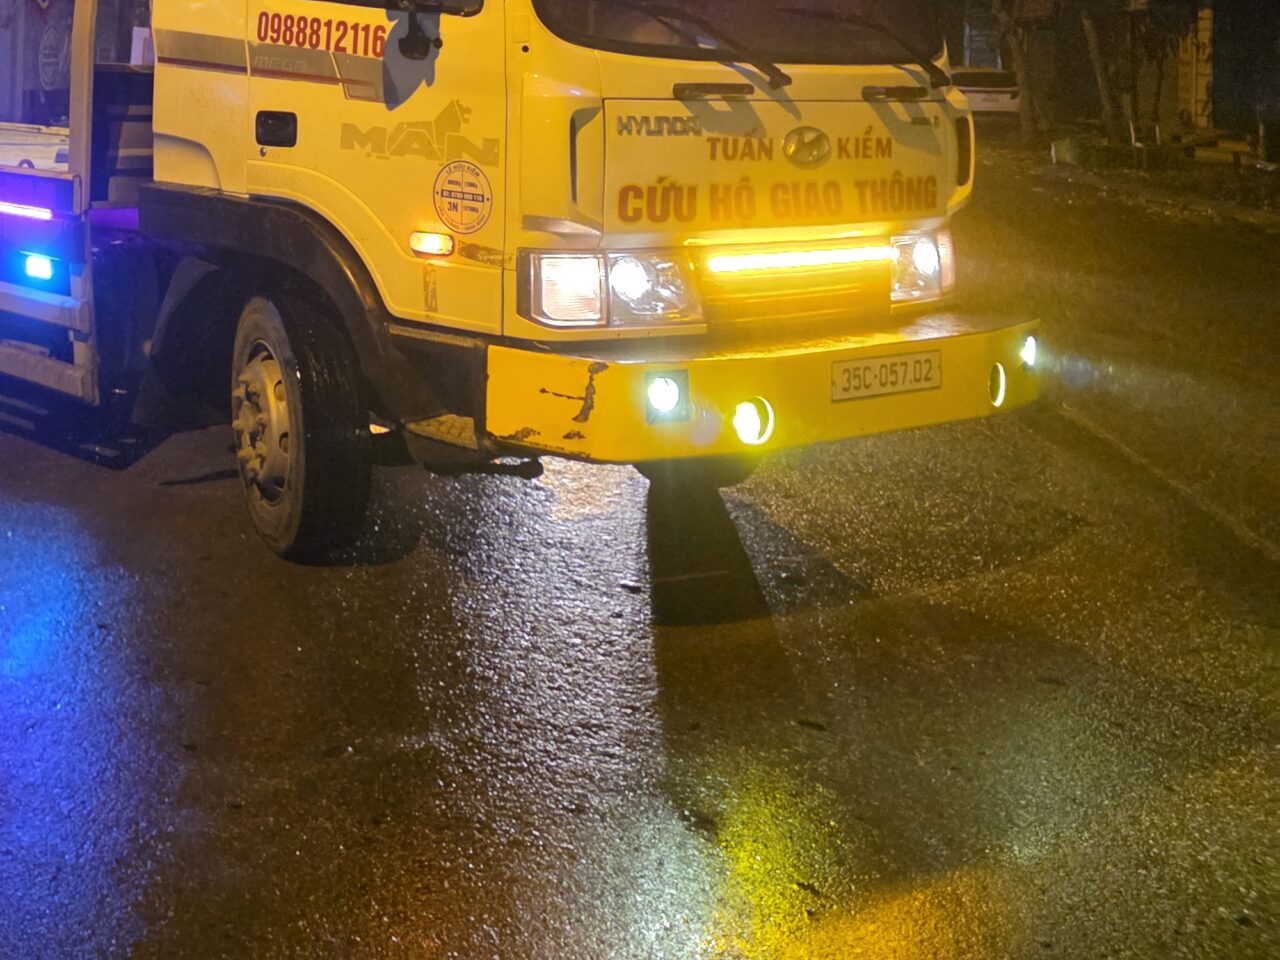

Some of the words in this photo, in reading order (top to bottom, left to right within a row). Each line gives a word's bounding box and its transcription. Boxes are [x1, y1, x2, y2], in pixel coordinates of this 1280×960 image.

[257, 11, 387, 58] 0988812116
[340, 121, 500, 167] MAN
[617, 115, 702, 137] HYUNDAI
[706, 128, 773, 161] TUẤN
[837, 125, 892, 159] KIỂM
[618, 175, 697, 222] CỨU
[770, 181, 842, 219] GIAO
[854, 170, 937, 213] THÔNG
